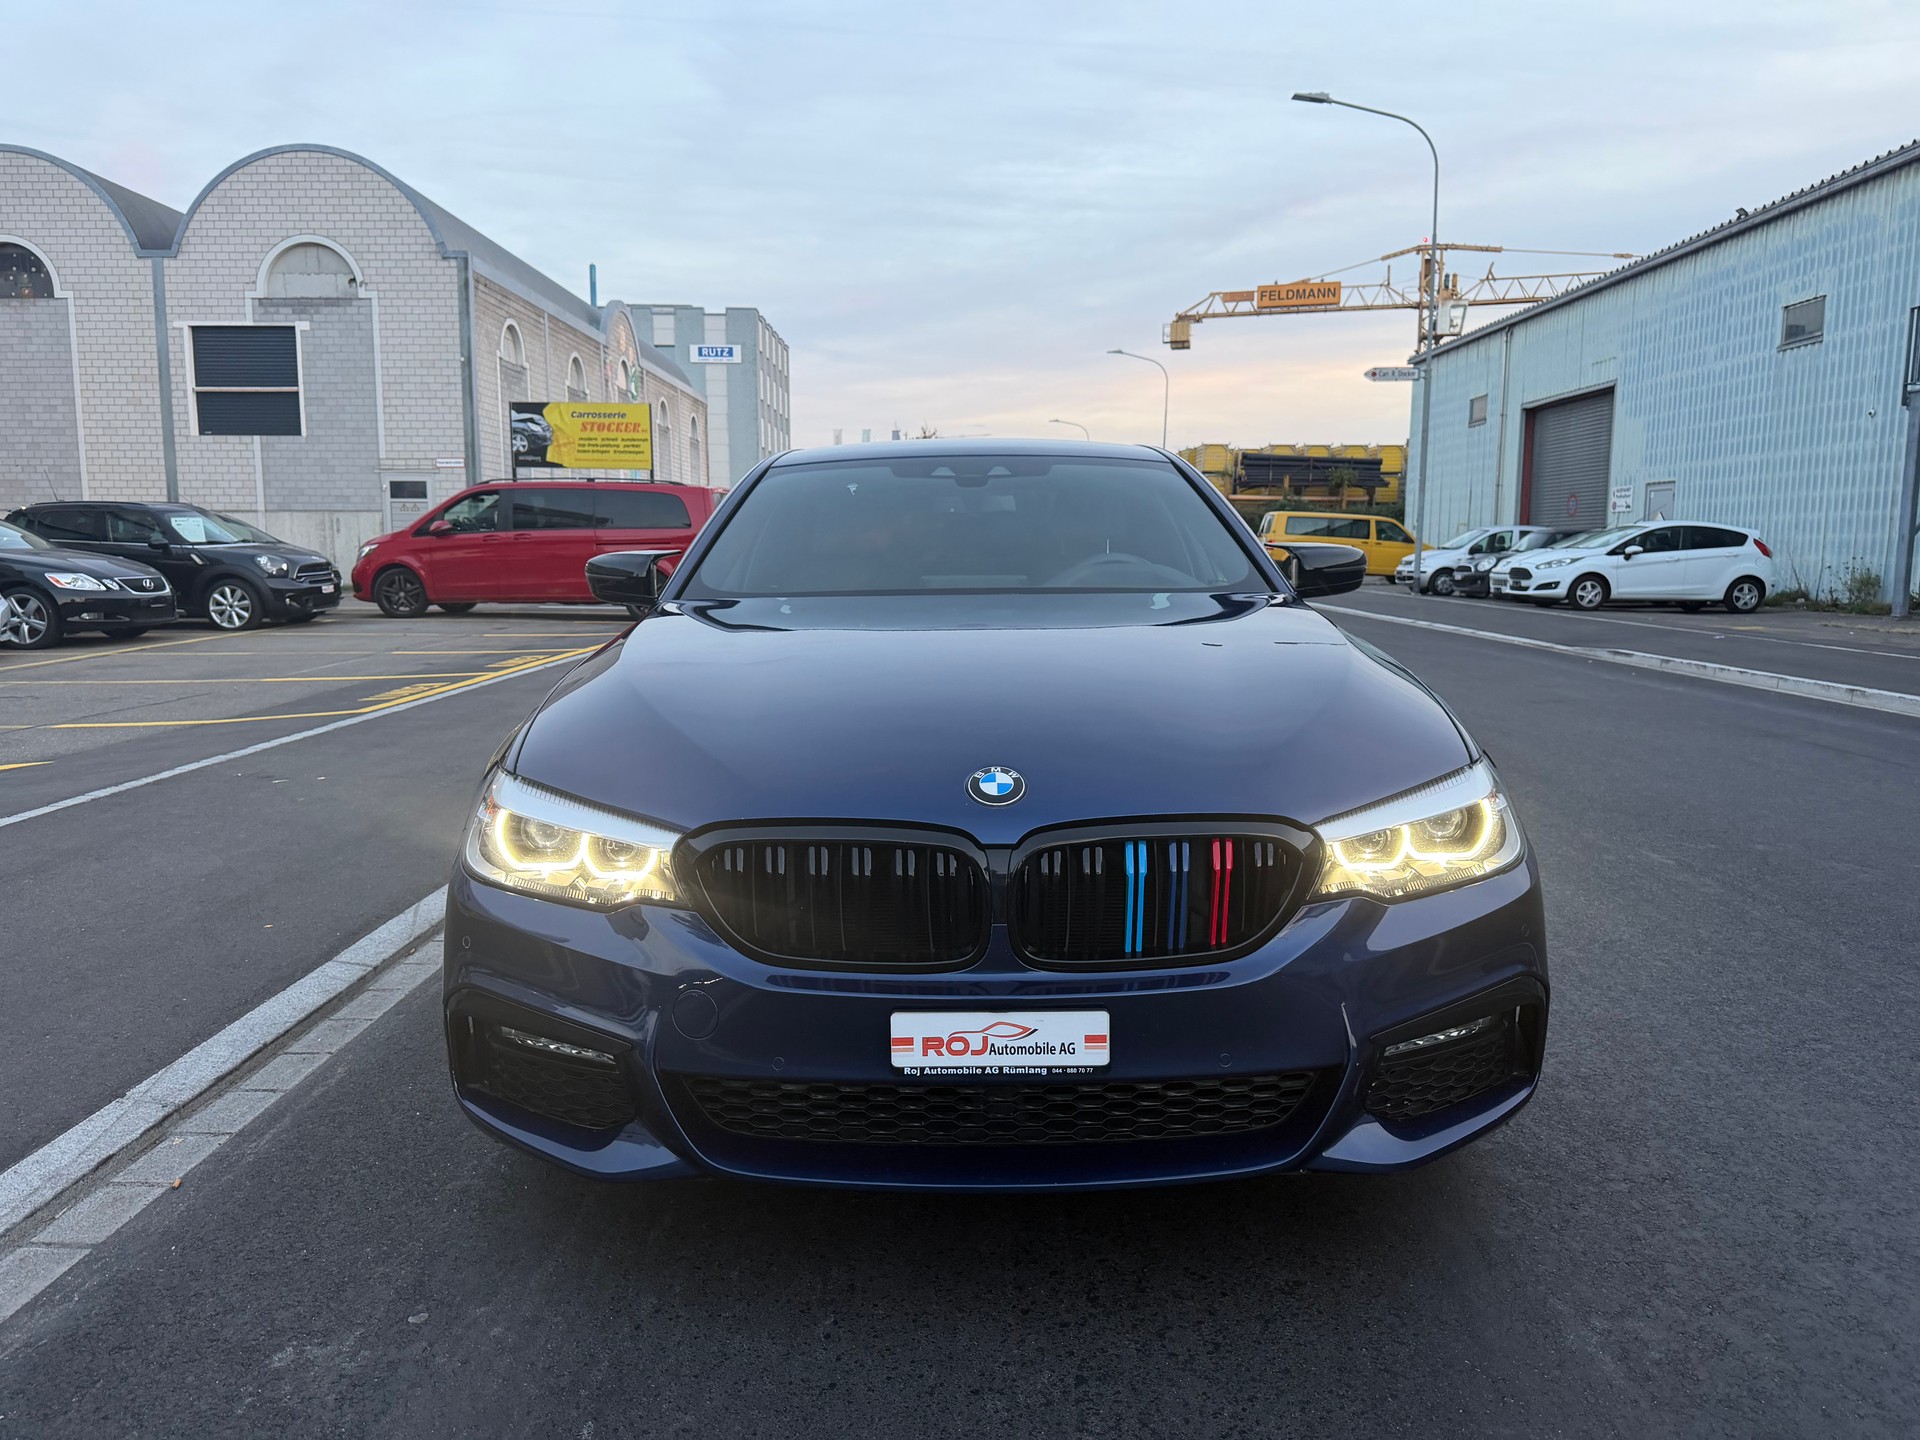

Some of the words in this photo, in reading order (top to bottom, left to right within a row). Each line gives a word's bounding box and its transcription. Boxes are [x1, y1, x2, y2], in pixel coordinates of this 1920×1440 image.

[1260, 287, 1337, 301] FELDMANN
[701, 347, 730, 357] RUTZ
[571, 411, 627, 419] Carrosserie
[580, 421, 641, 433] STOCKER
[974, 767, 1021, 778] BMW
[922, 1036, 989, 1056] ROJ
[989, 1041, 1056, 1056] Automobile
[1059, 1042, 1076, 1055] AG
[904, 1067, 920, 1076] Roj
[924, 1067, 982, 1075] Automobile
[1003, 1066, 1047, 1075] Rümlang
